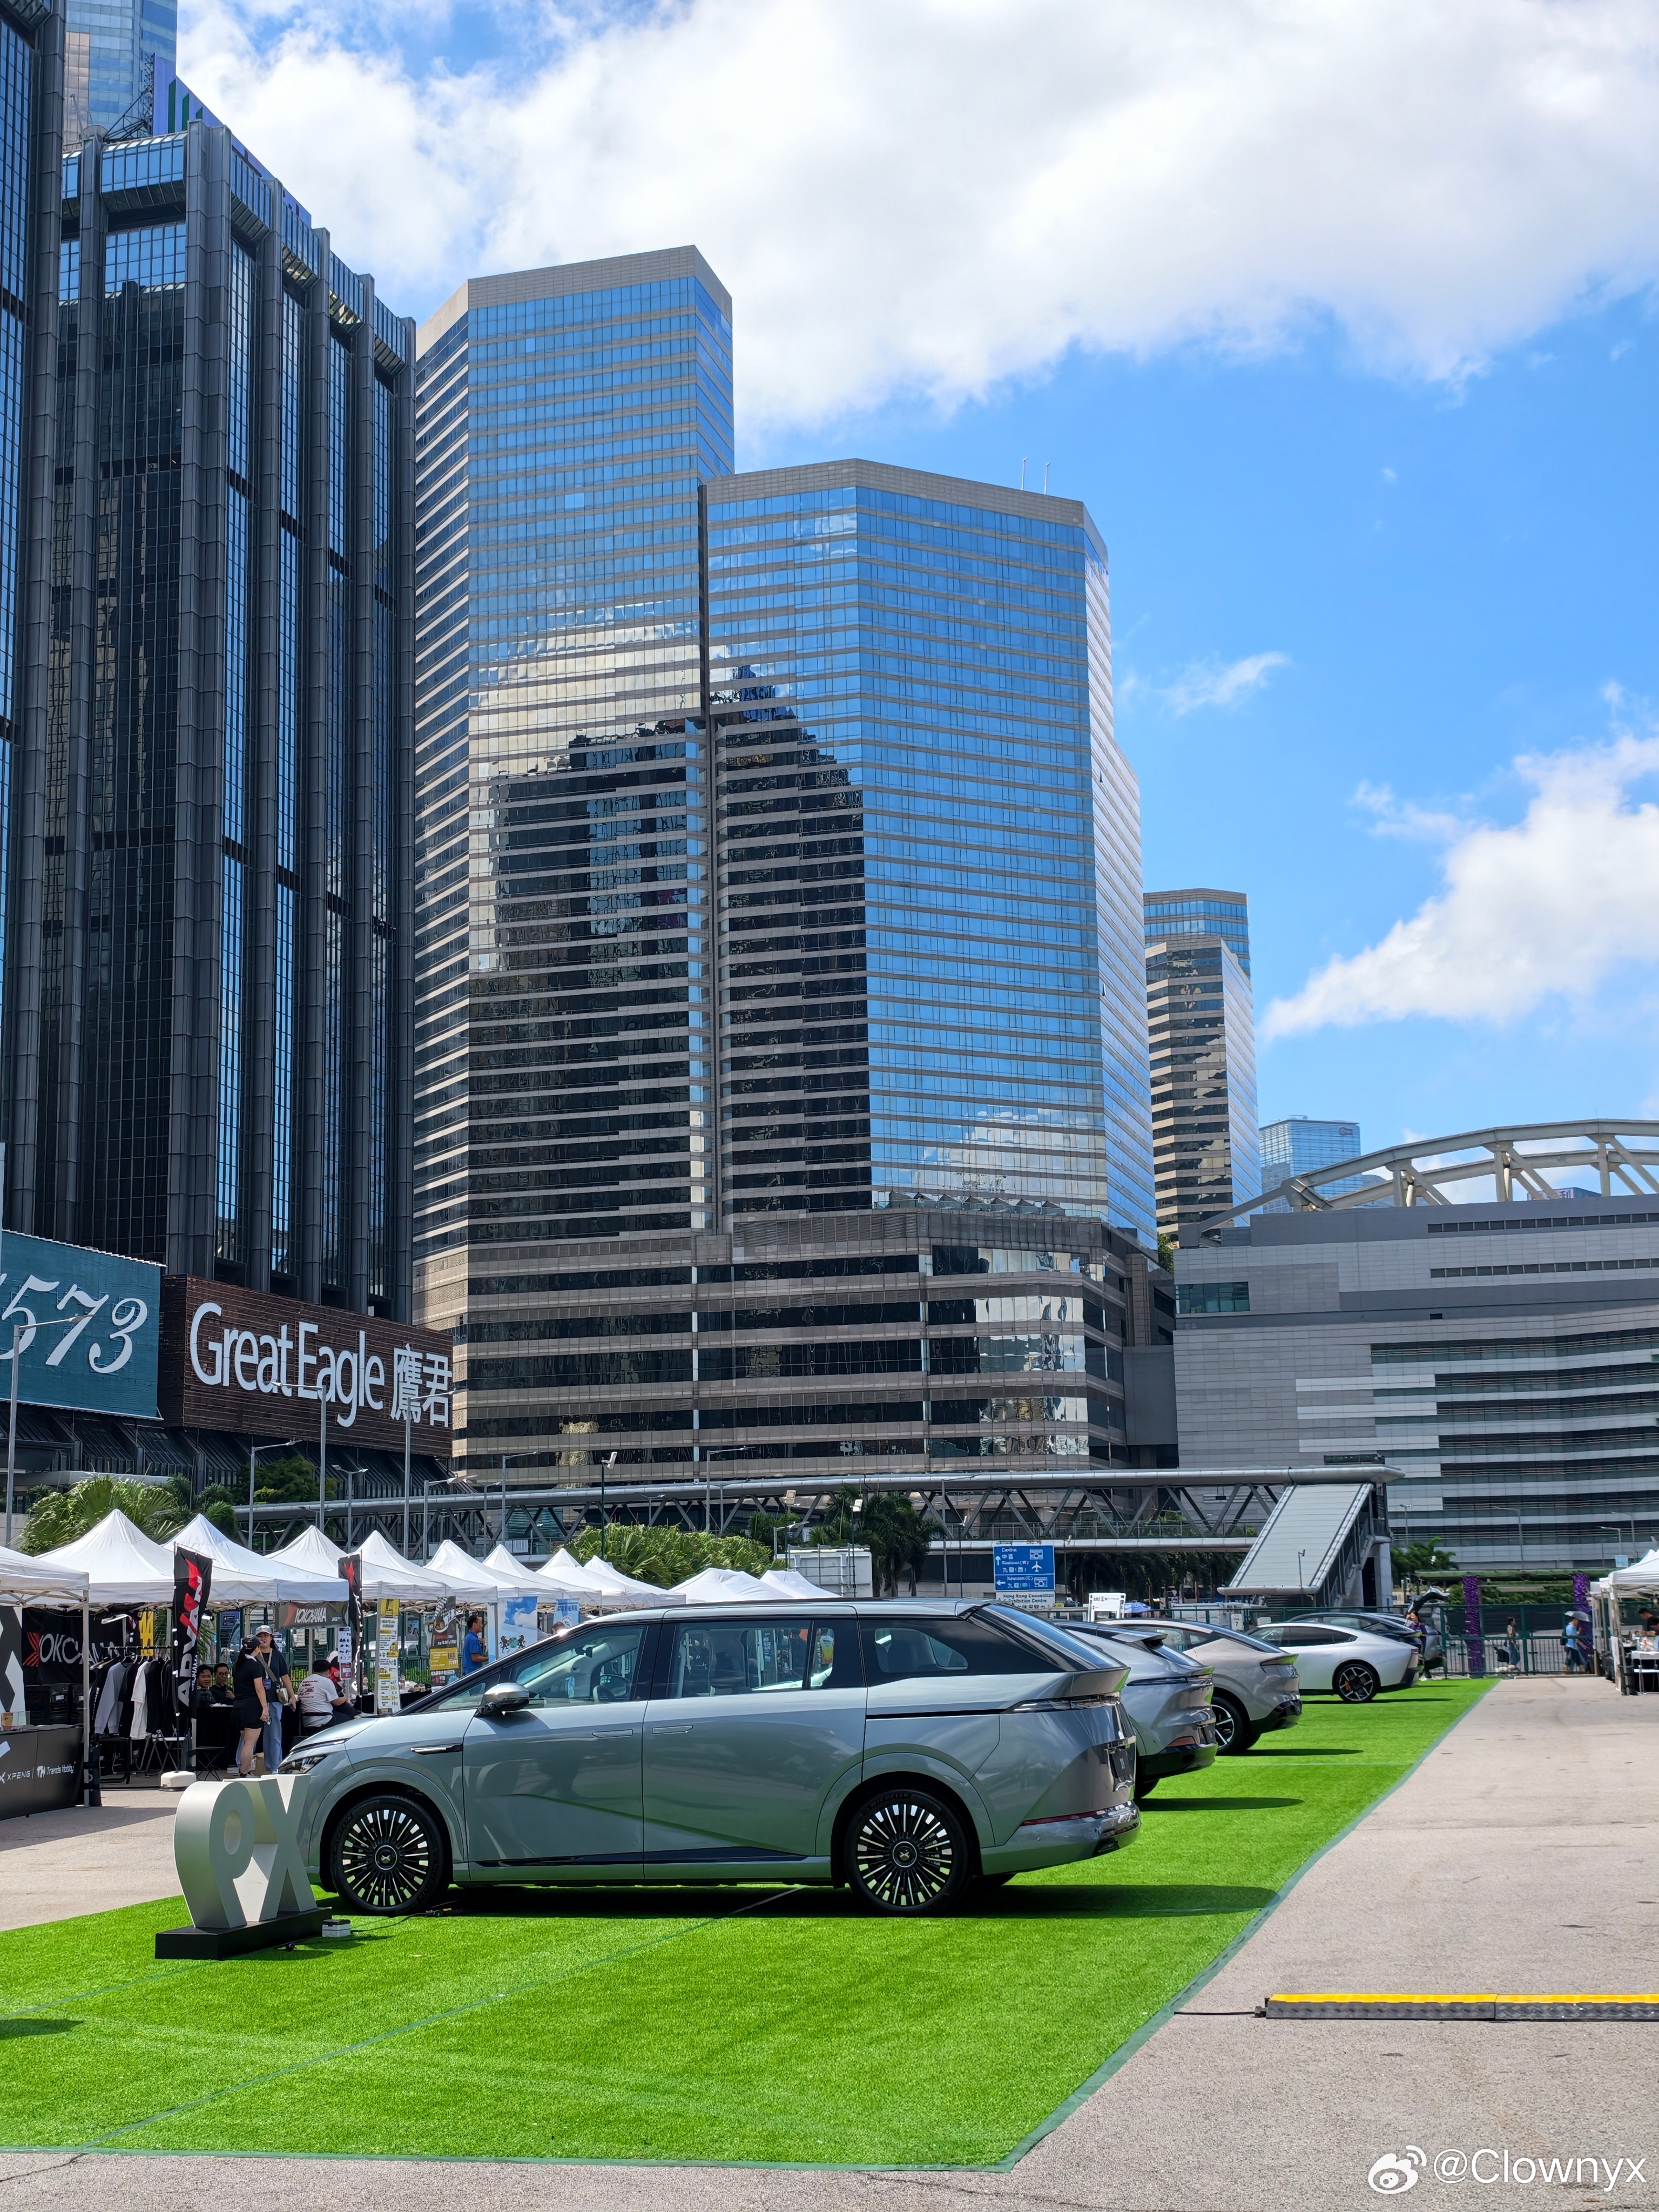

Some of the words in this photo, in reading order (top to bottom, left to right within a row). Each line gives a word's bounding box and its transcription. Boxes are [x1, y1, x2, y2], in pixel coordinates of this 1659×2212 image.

[0, 1273, 147, 1373] 573
[390, 1343, 452, 1428] 鷹君
[294, 1607, 327, 1623] YOKOHAMA
[7, 1770, 31, 1781] XPENG
